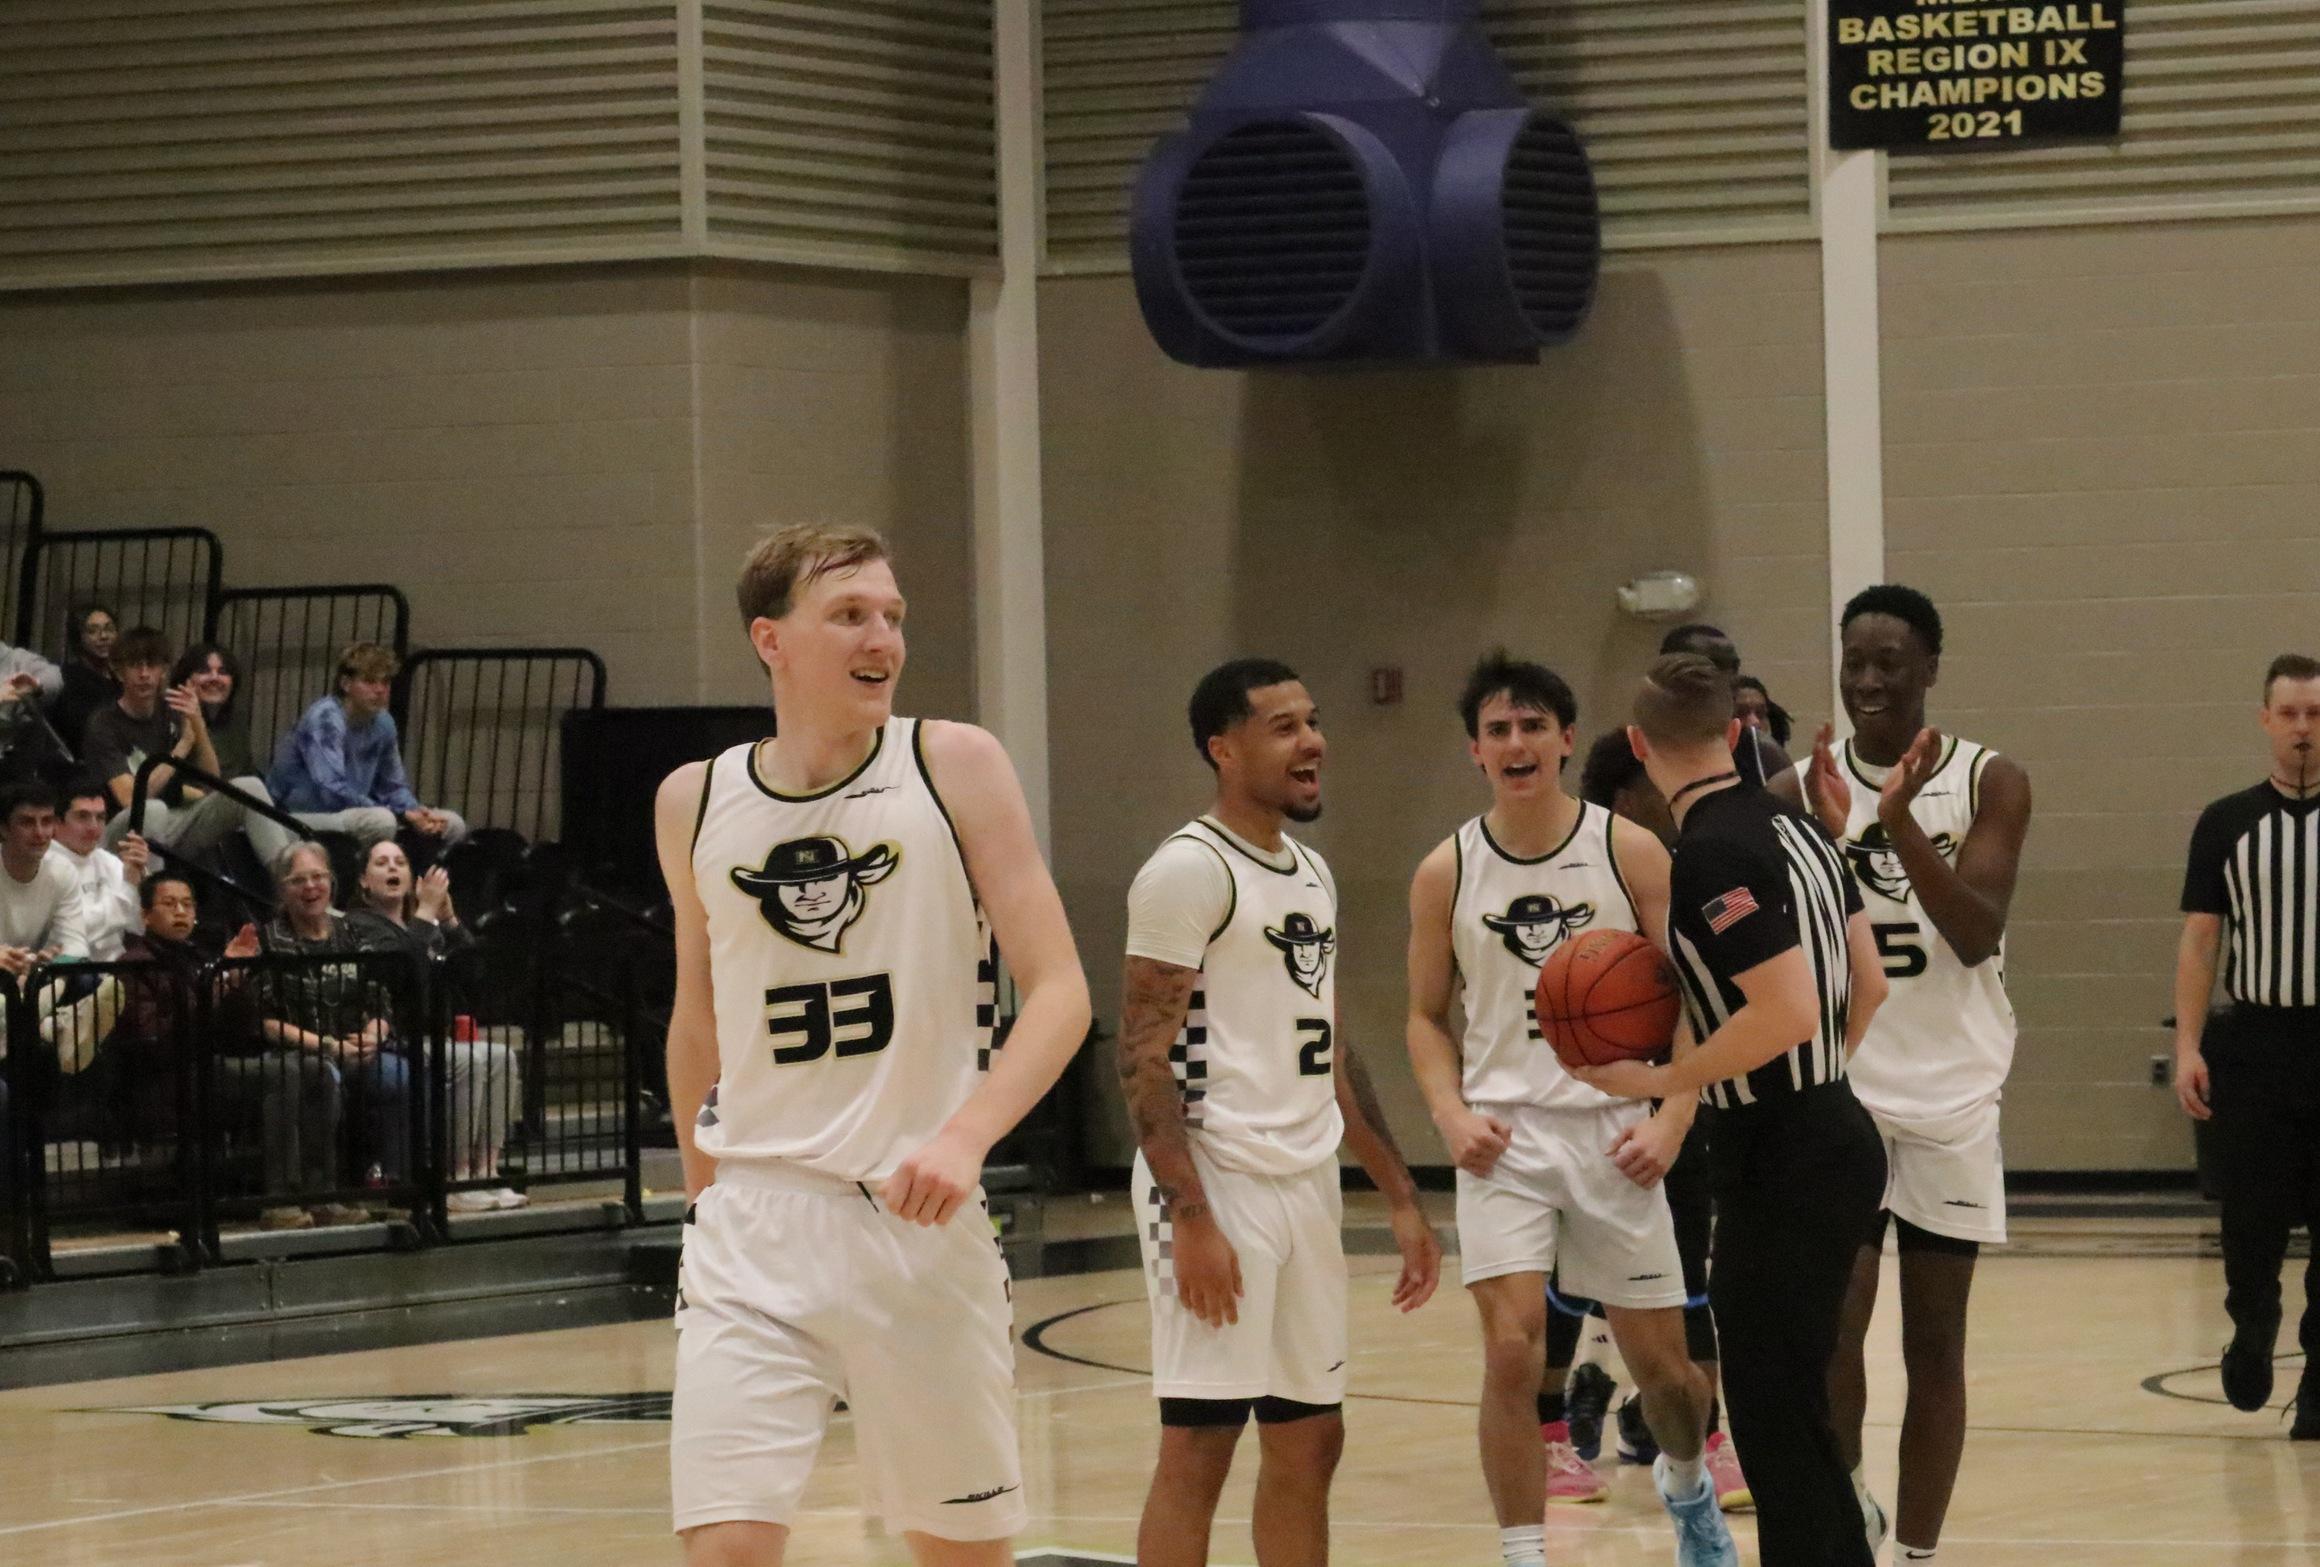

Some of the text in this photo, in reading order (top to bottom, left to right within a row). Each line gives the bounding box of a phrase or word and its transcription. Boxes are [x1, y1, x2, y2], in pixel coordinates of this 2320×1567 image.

[1838, 4, 2116, 44] BASKETBALL
[1867, 38, 2088, 77] REGION IX
[1850, 71, 2106, 110] CHAMPIONS
[1927, 110, 2023, 140] 2021
[1871, 922, 1928, 978] 5
[764, 972, 895, 1065] 33
[1296, 1018, 1332, 1077] 2
